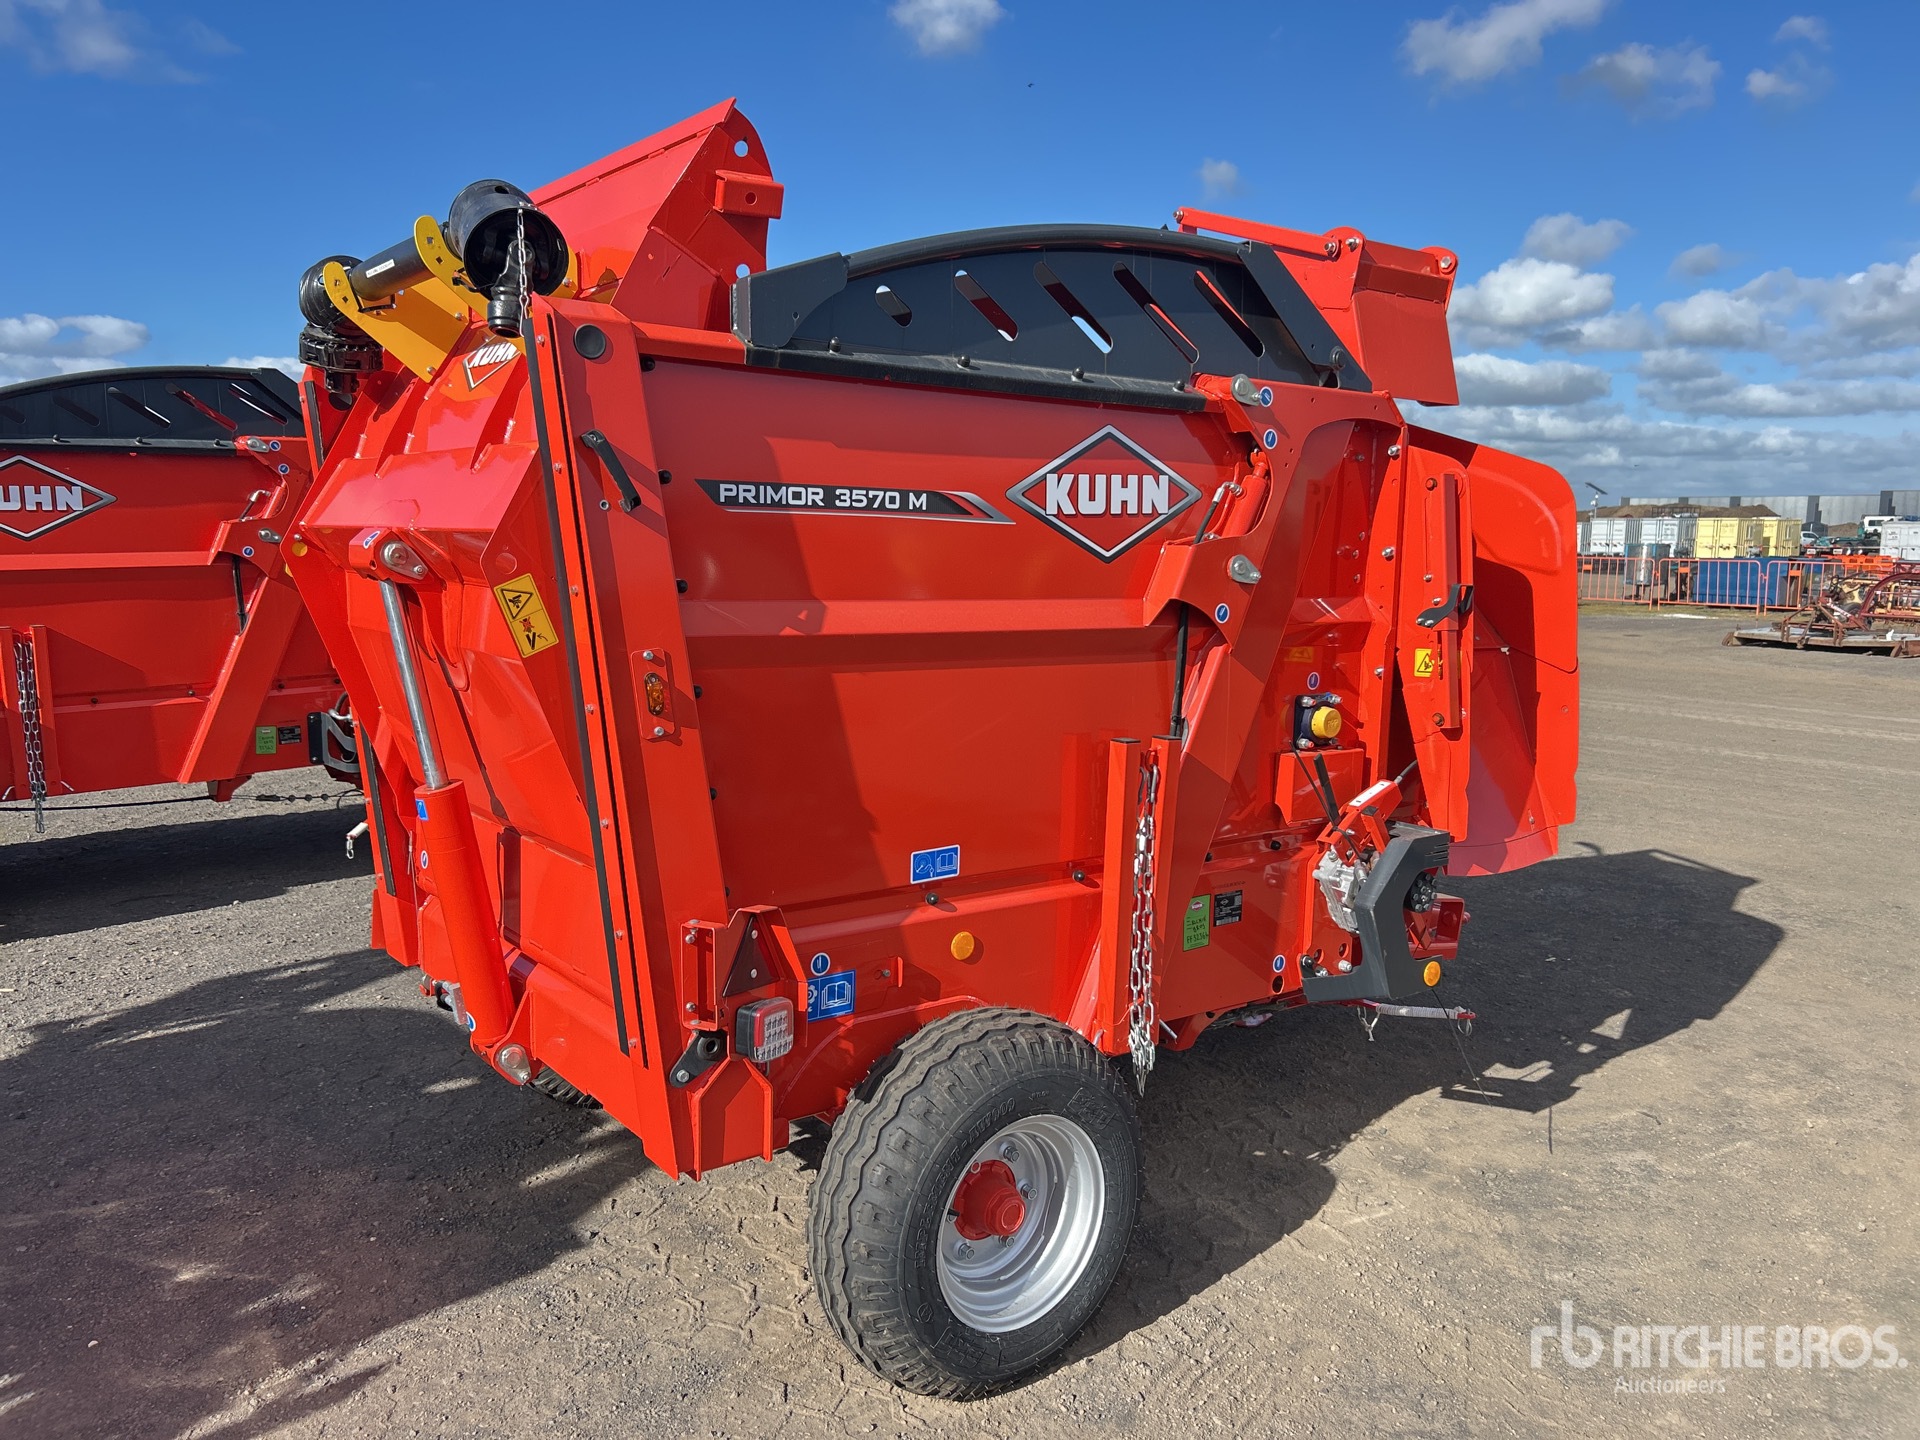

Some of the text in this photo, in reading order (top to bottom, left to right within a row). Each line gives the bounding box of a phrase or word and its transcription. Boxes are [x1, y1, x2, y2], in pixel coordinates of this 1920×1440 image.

[467, 342, 518, 369] KUHN
[0, 485, 84, 511] UHN
[719, 483, 928, 511] PRIMOR 3570 M
[1045, 473, 1170, 515] KUHN
